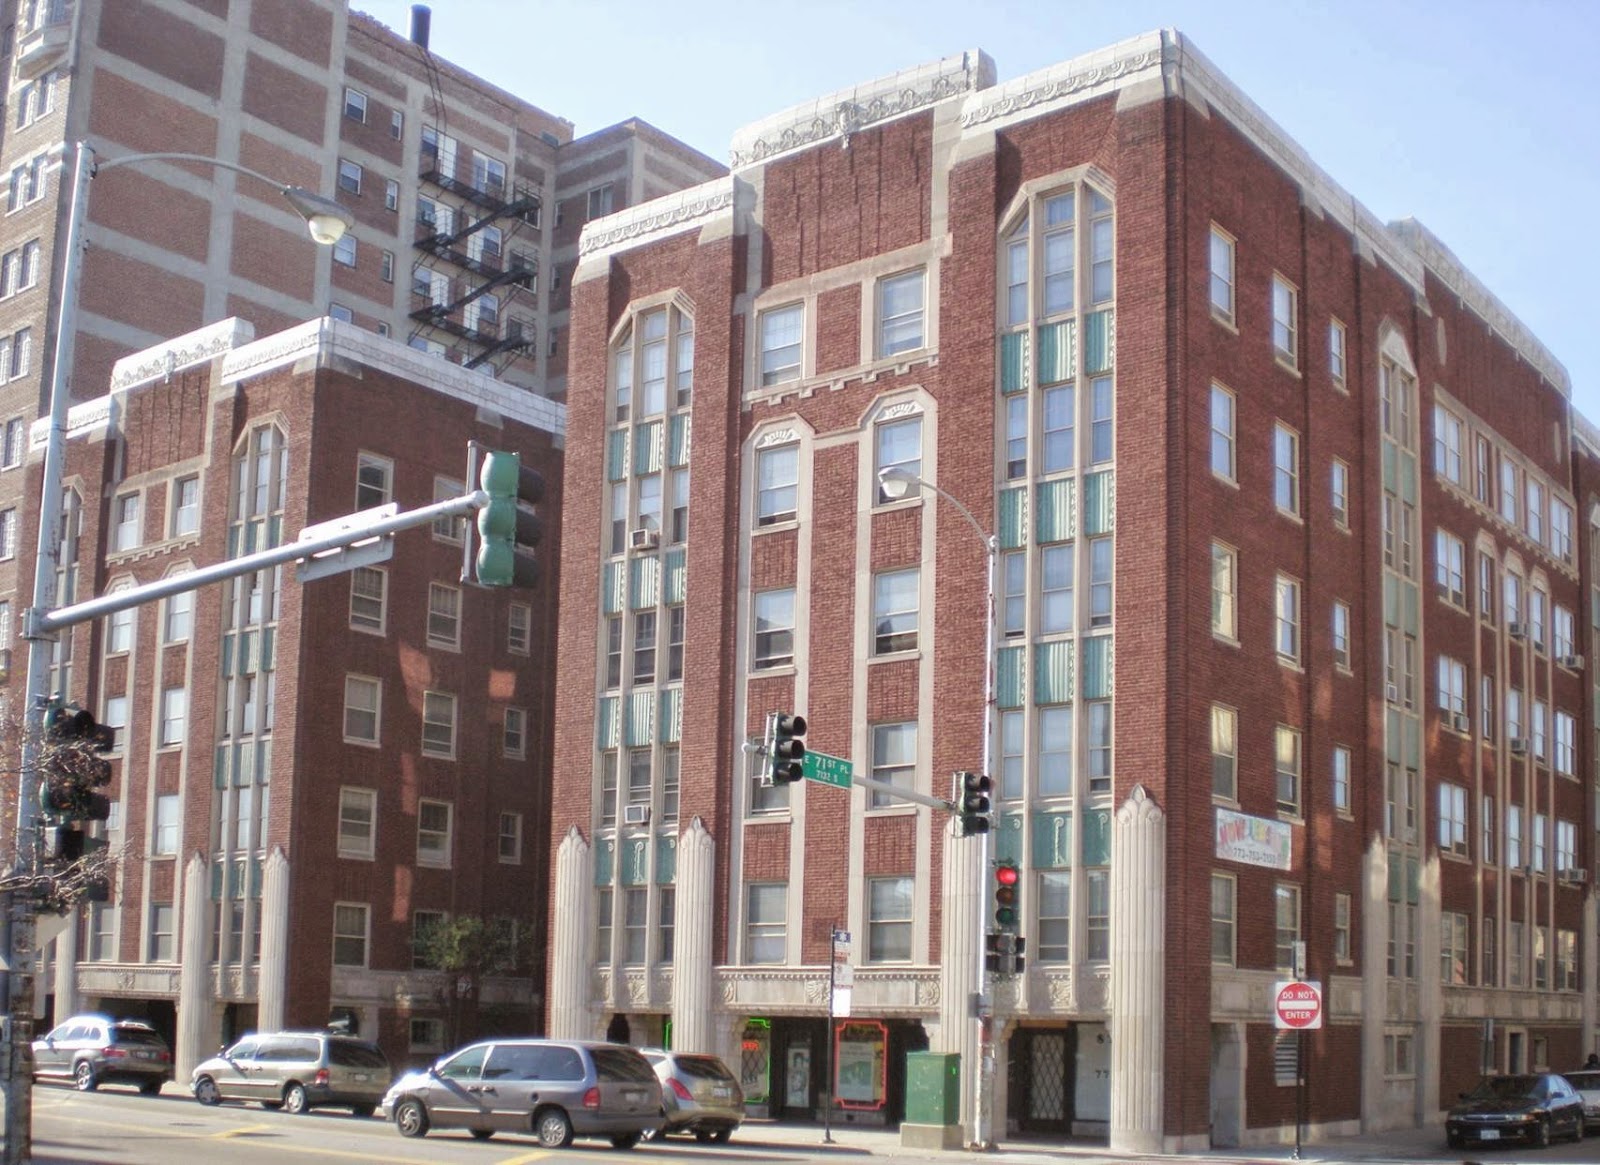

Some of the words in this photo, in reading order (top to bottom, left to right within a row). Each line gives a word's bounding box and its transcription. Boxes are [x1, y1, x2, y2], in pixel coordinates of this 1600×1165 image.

[804, 755, 810, 763] E
[815, 756, 836, 769] 71ST
[839, 765, 849, 774] PL
[1282, 991, 1294, 999] DO
[1297, 991, 1314, 999] NOT
[1285, 1011, 1311, 1019] ENTER
